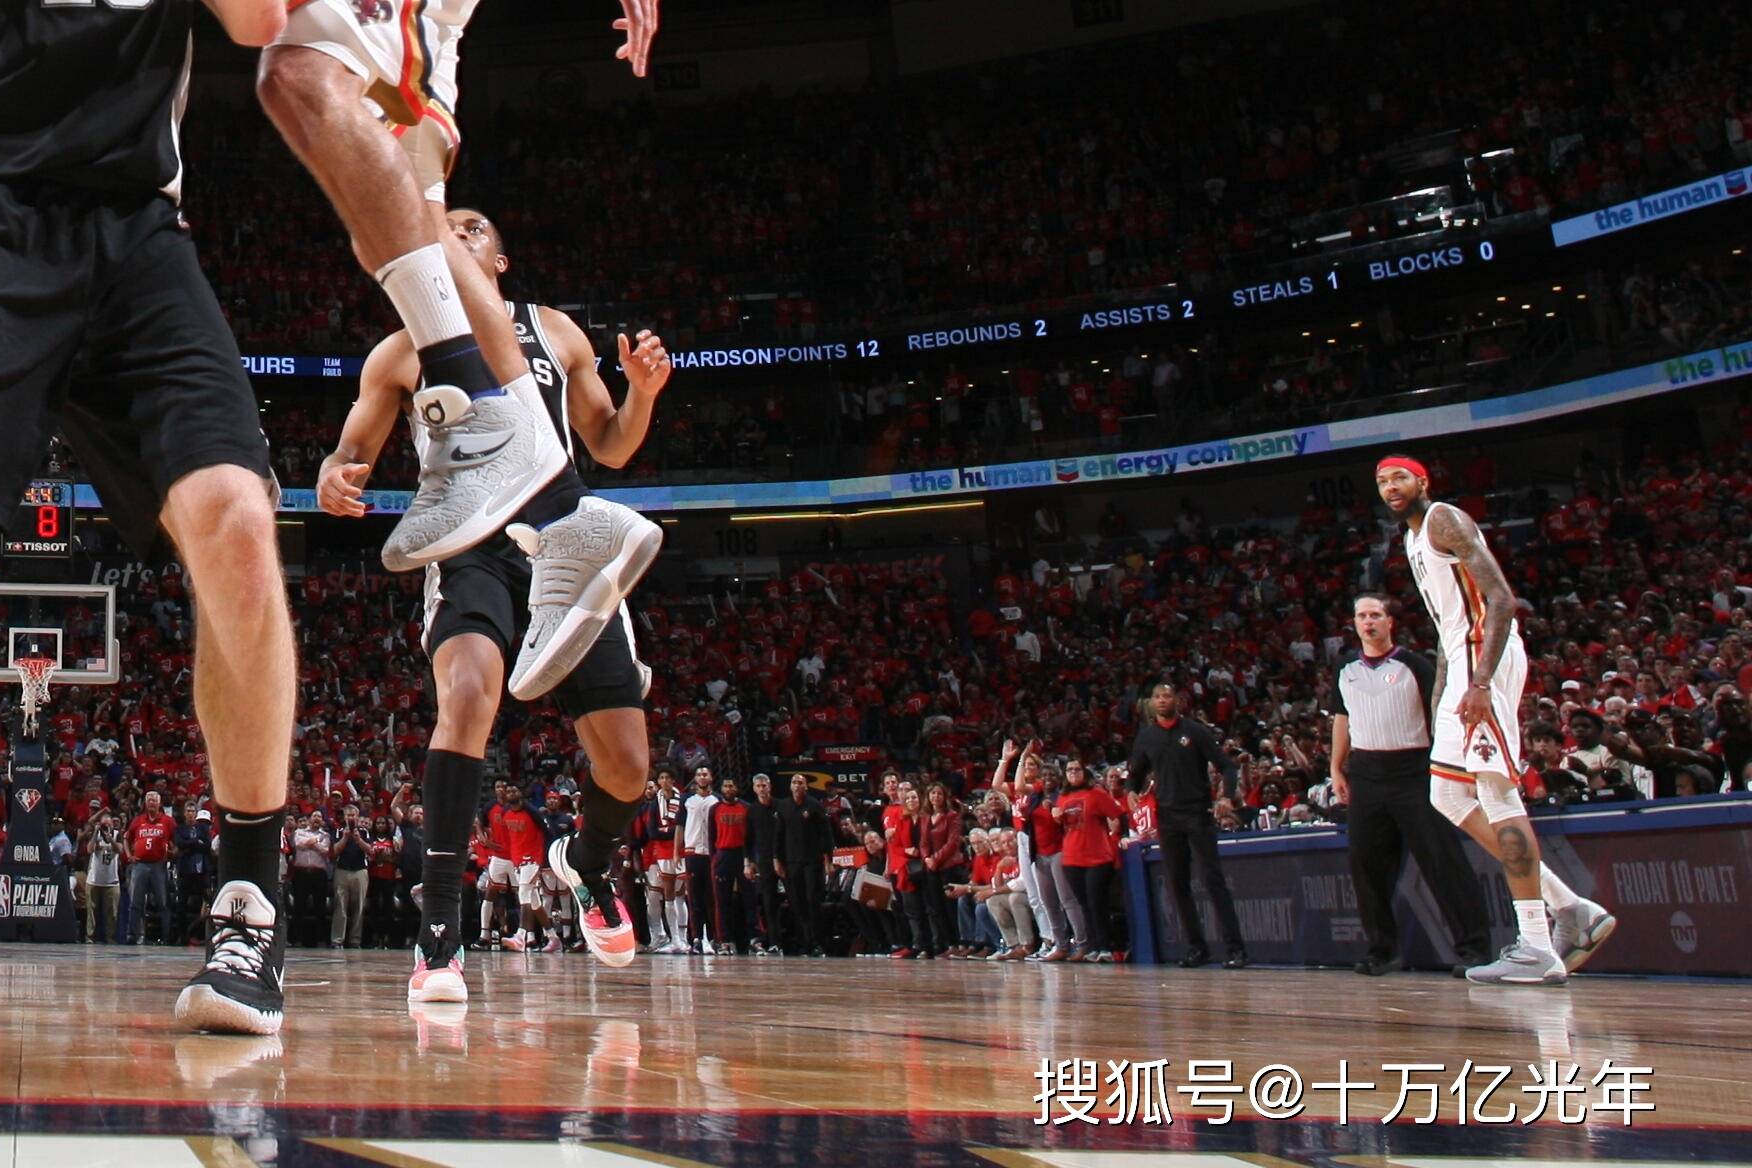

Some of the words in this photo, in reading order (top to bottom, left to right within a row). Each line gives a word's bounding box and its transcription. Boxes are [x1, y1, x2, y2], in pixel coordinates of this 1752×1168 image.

[1595, 207, 1633, 230] the
[1638, 182, 1722, 220] human
[1368, 247, 1465, 281] BLOCKS
[1480, 241, 1494, 262] 0
[1233, 276, 1314, 307] STEALS
[1327, 271, 1339, 290] 1
[1080, 304, 1171, 330] ASSISTS
[1183, 300, 1195, 318] 2
[908, 322, 1022, 351] REBOUNDS
[1035, 319, 1048, 337] 2
[241, 357, 295, 375] PURS
[774, 343, 848, 364] POINTS
[856, 339, 880, 358] 12
[1665, 357, 1714, 385] the
[909, 470, 952, 493] the
[958, 462, 1051, 491] human
[1083, 446, 1178, 479] energy
[1186, 431, 1308, 467] company
[36, 505, 61, 540] 8
[24, 542, 68, 553] TISSOT
[90, 561, 154, 589] Let's
[837, 773, 868, 783] BET
[13, 845, 40, 863] @NBA
[13, 883, 59, 906] PLAY-IN
[1612, 861, 1672, 905] FRIDAY
[1671, 860, 1694, 904] 10
